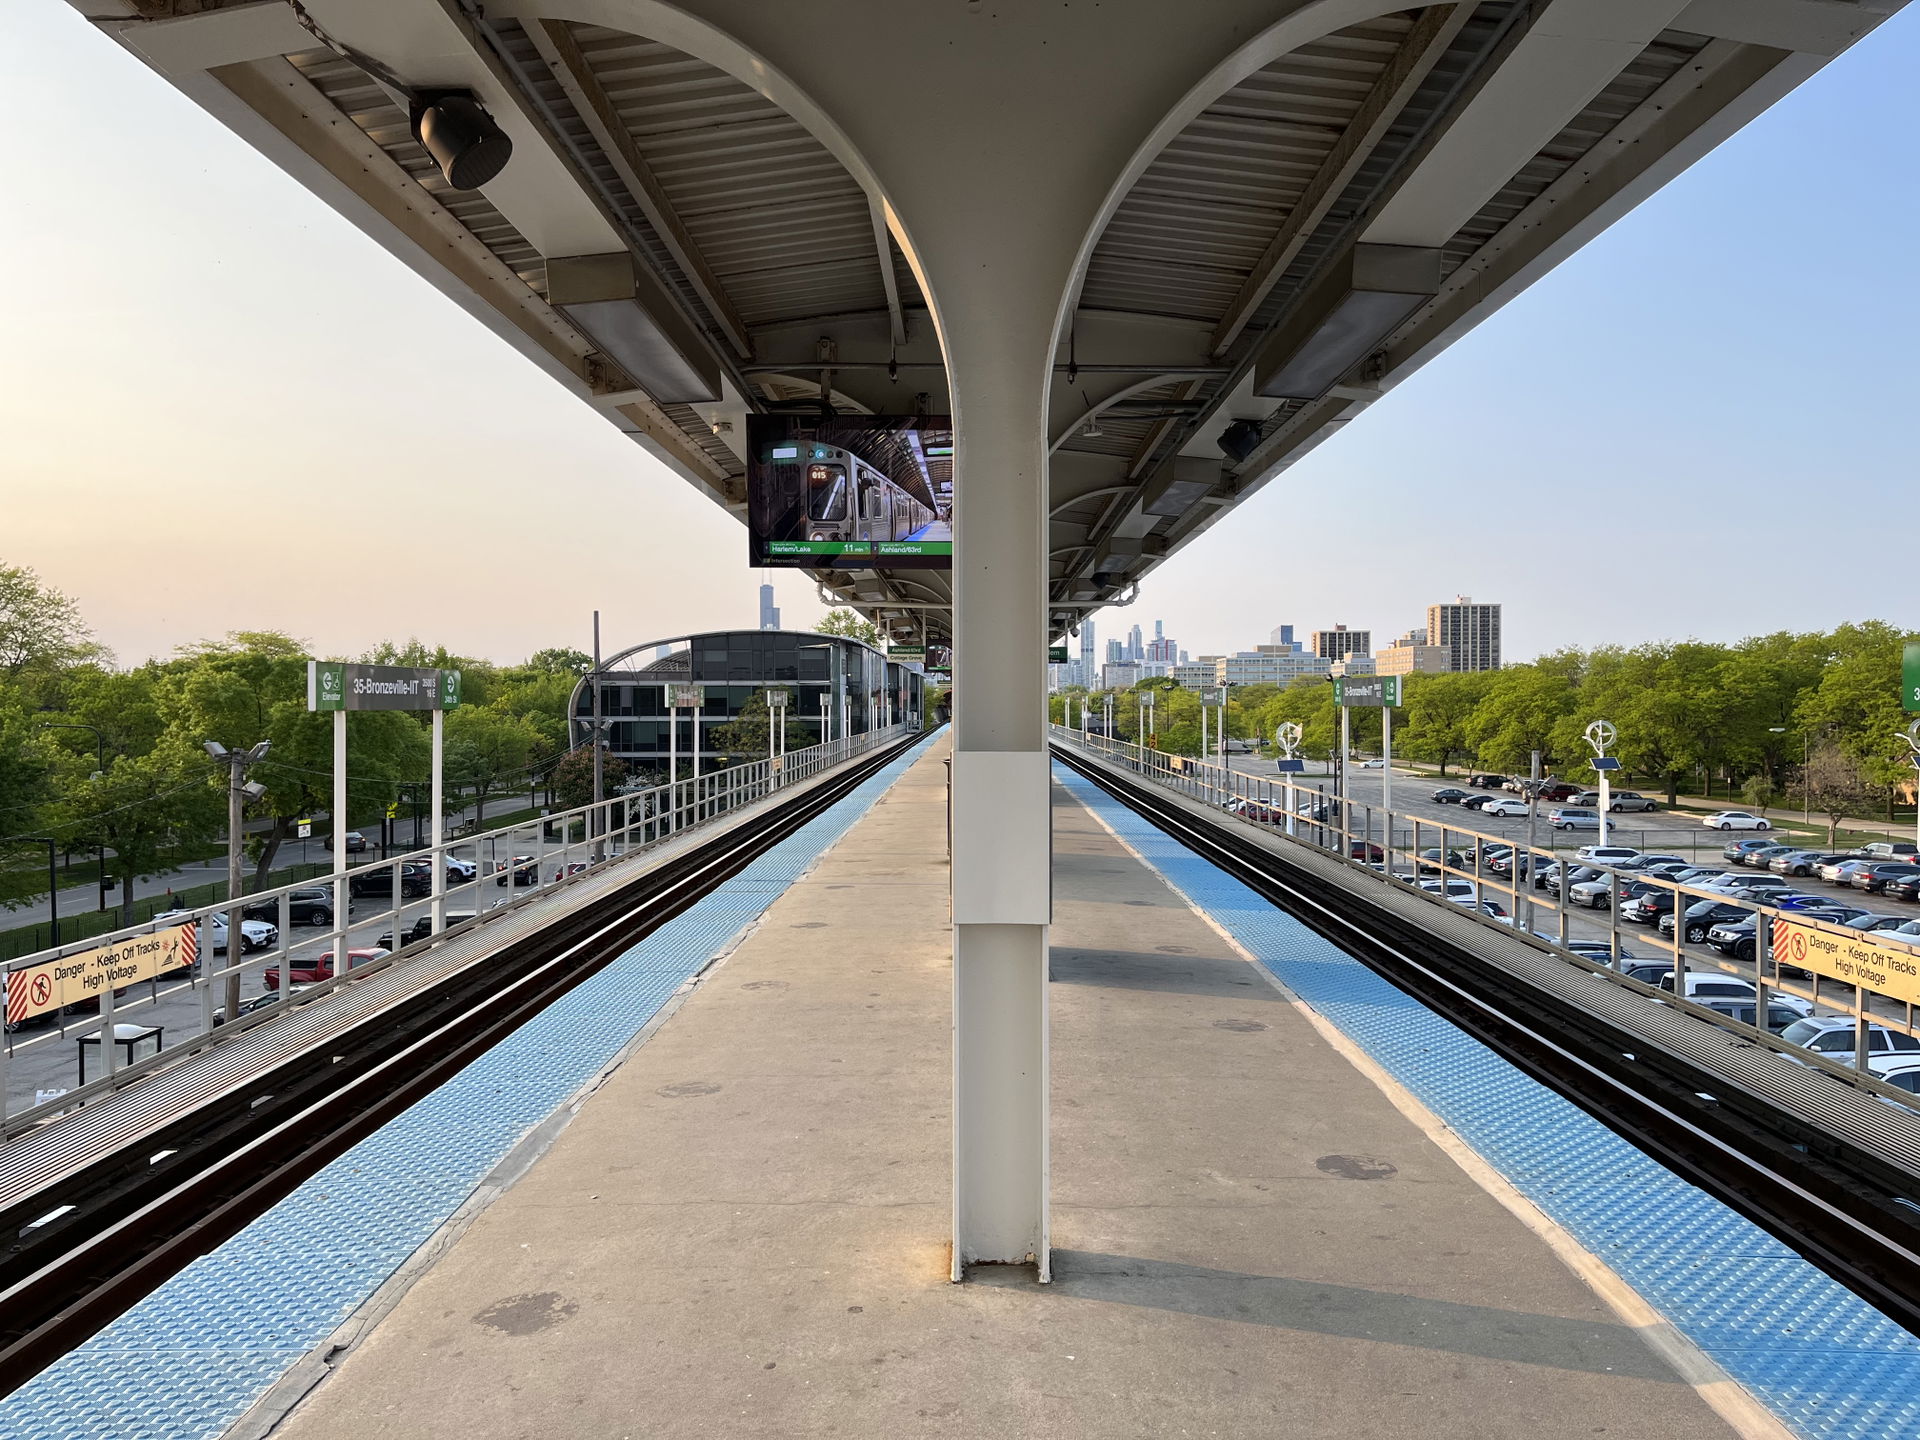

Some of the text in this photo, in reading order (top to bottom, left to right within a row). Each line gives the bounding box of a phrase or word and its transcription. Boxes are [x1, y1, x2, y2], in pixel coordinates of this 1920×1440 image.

[844, 544, 853, 552] 11
[322, 691, 341, 700] Elevator
[353, 678, 419, 694] 35-Bronzeville-IIT
[432, 689, 436, 698] E
[54, 962, 86, 981] Danger
[97, 953, 120, 968] Keep
[122, 946, 135, 960] Off
[136, 940, 160, 957] Tracks
[1810, 935, 1839, 954] Danger
[1848, 946, 1869, 964] Keep
[1871, 952, 1885, 967] Off
[1886, 956, 1917, 976] Tracks
[83, 964, 138, 989] High Voltage
[1835, 958, 1886, 985] High Voltage
